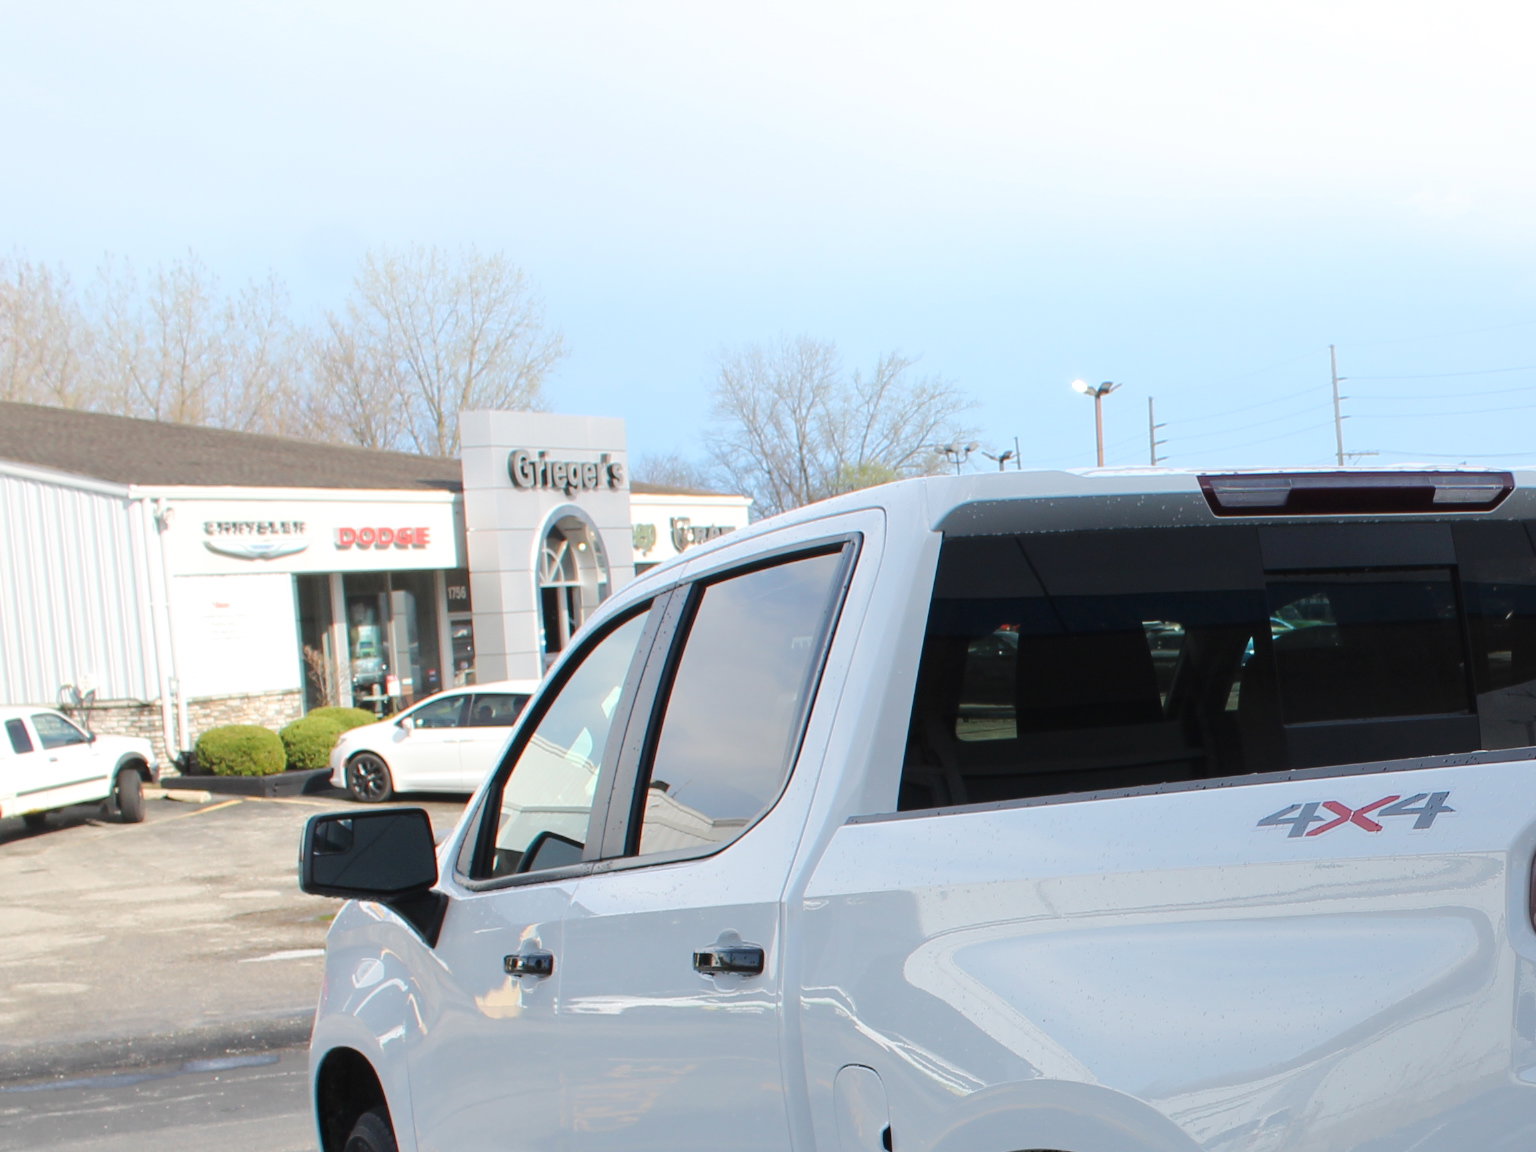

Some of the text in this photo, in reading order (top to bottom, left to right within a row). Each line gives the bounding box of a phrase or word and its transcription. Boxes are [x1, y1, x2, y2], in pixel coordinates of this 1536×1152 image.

[507, 448, 626, 496] Grieger's
[336, 526, 431, 550] DODGE
[447, 585, 467, 601] 1756
